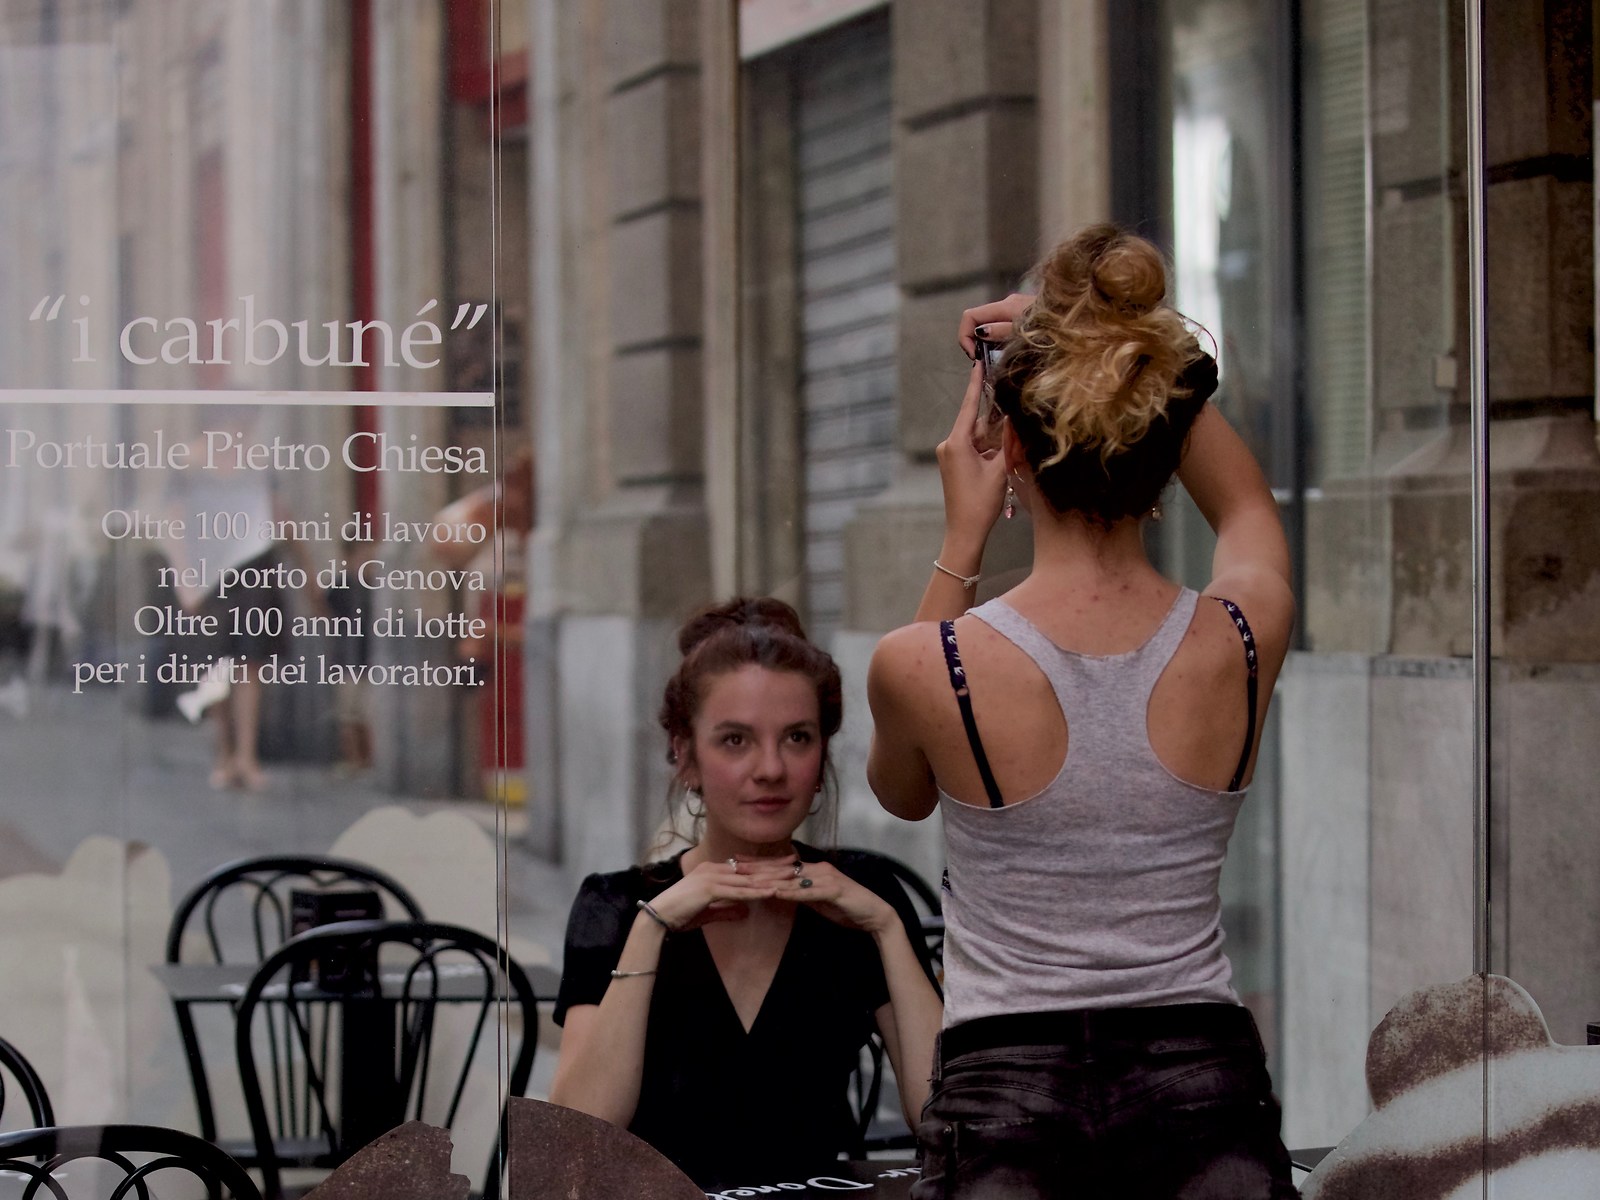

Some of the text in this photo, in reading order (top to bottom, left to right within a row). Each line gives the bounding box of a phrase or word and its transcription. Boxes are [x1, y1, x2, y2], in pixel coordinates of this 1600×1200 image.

[119, 294, 488, 369] carbuné”
[5, 429, 489, 474] Portuale Pietro Chiesa
[101, 509, 487, 543] Oltre 100 anni di lavoro
[158, 559, 487, 598] nel porto di Genova
[134, 606, 487, 640] Oltre 100 anni di lotte
[72, 654, 485, 694] per i diritti dei lavoratori.
